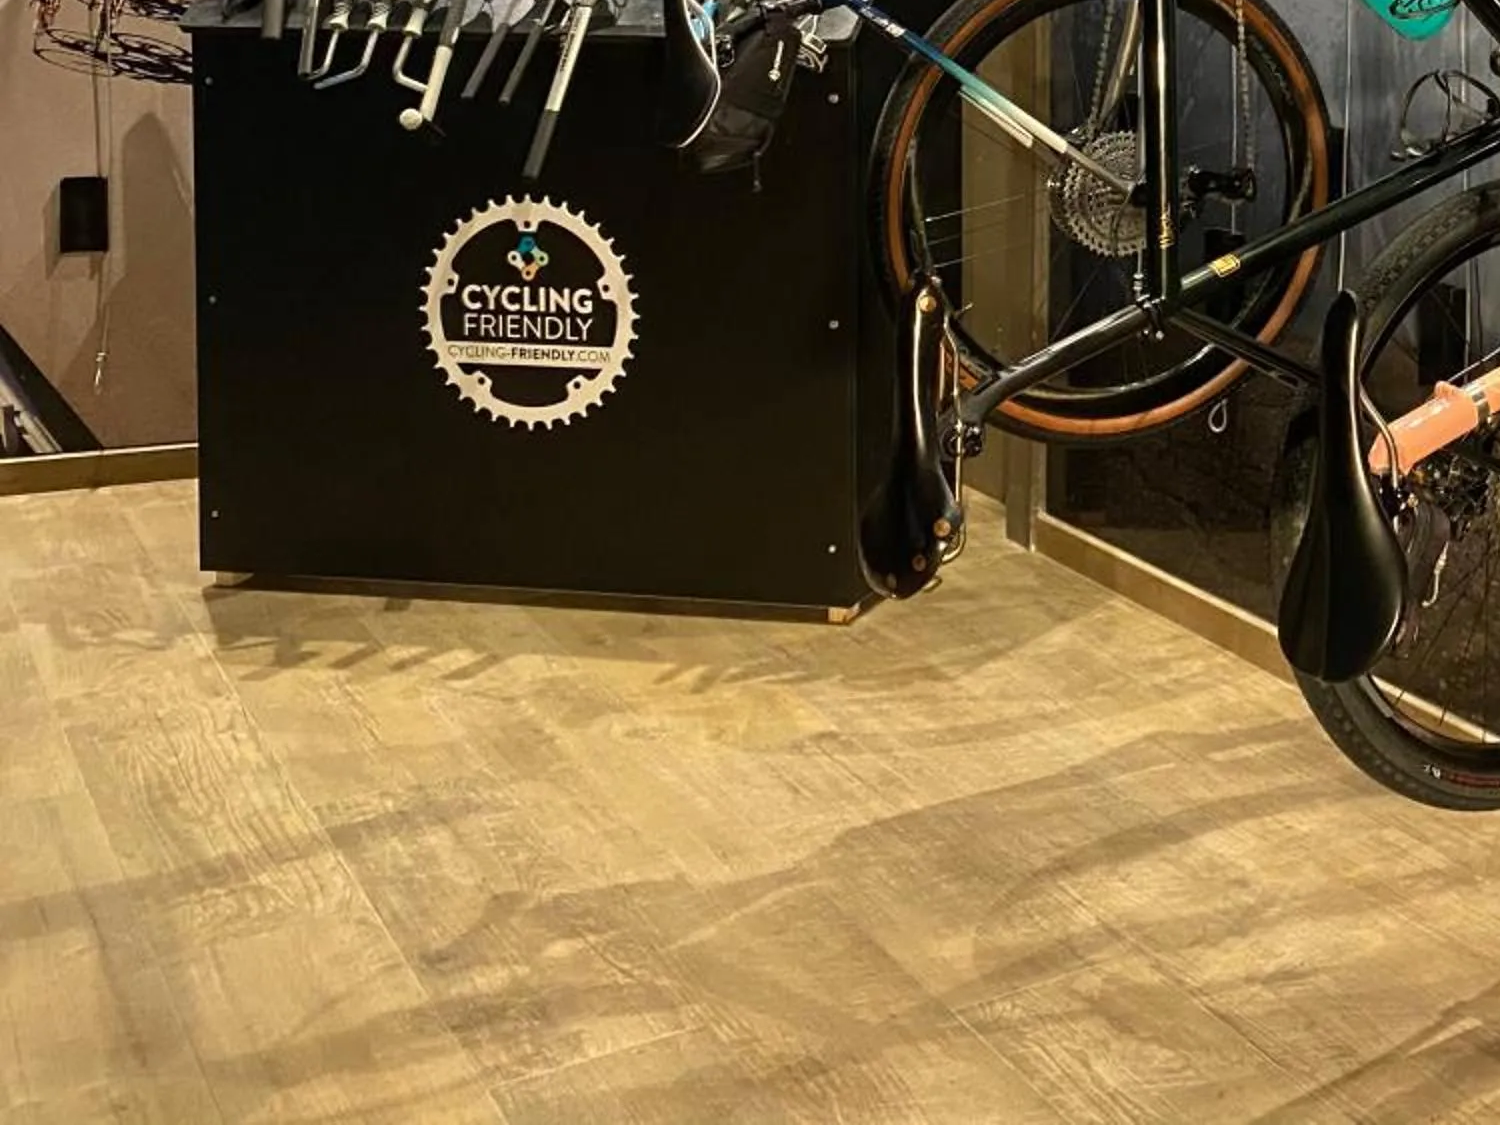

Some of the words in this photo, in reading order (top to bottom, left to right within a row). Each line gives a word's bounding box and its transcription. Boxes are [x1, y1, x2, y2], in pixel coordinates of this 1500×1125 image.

[461, 283, 593, 315] CYCLING
[463, 312, 593, 342] FRIENDLY
[448, 344, 611, 364] CYCLING-FRIENDLY.COM
